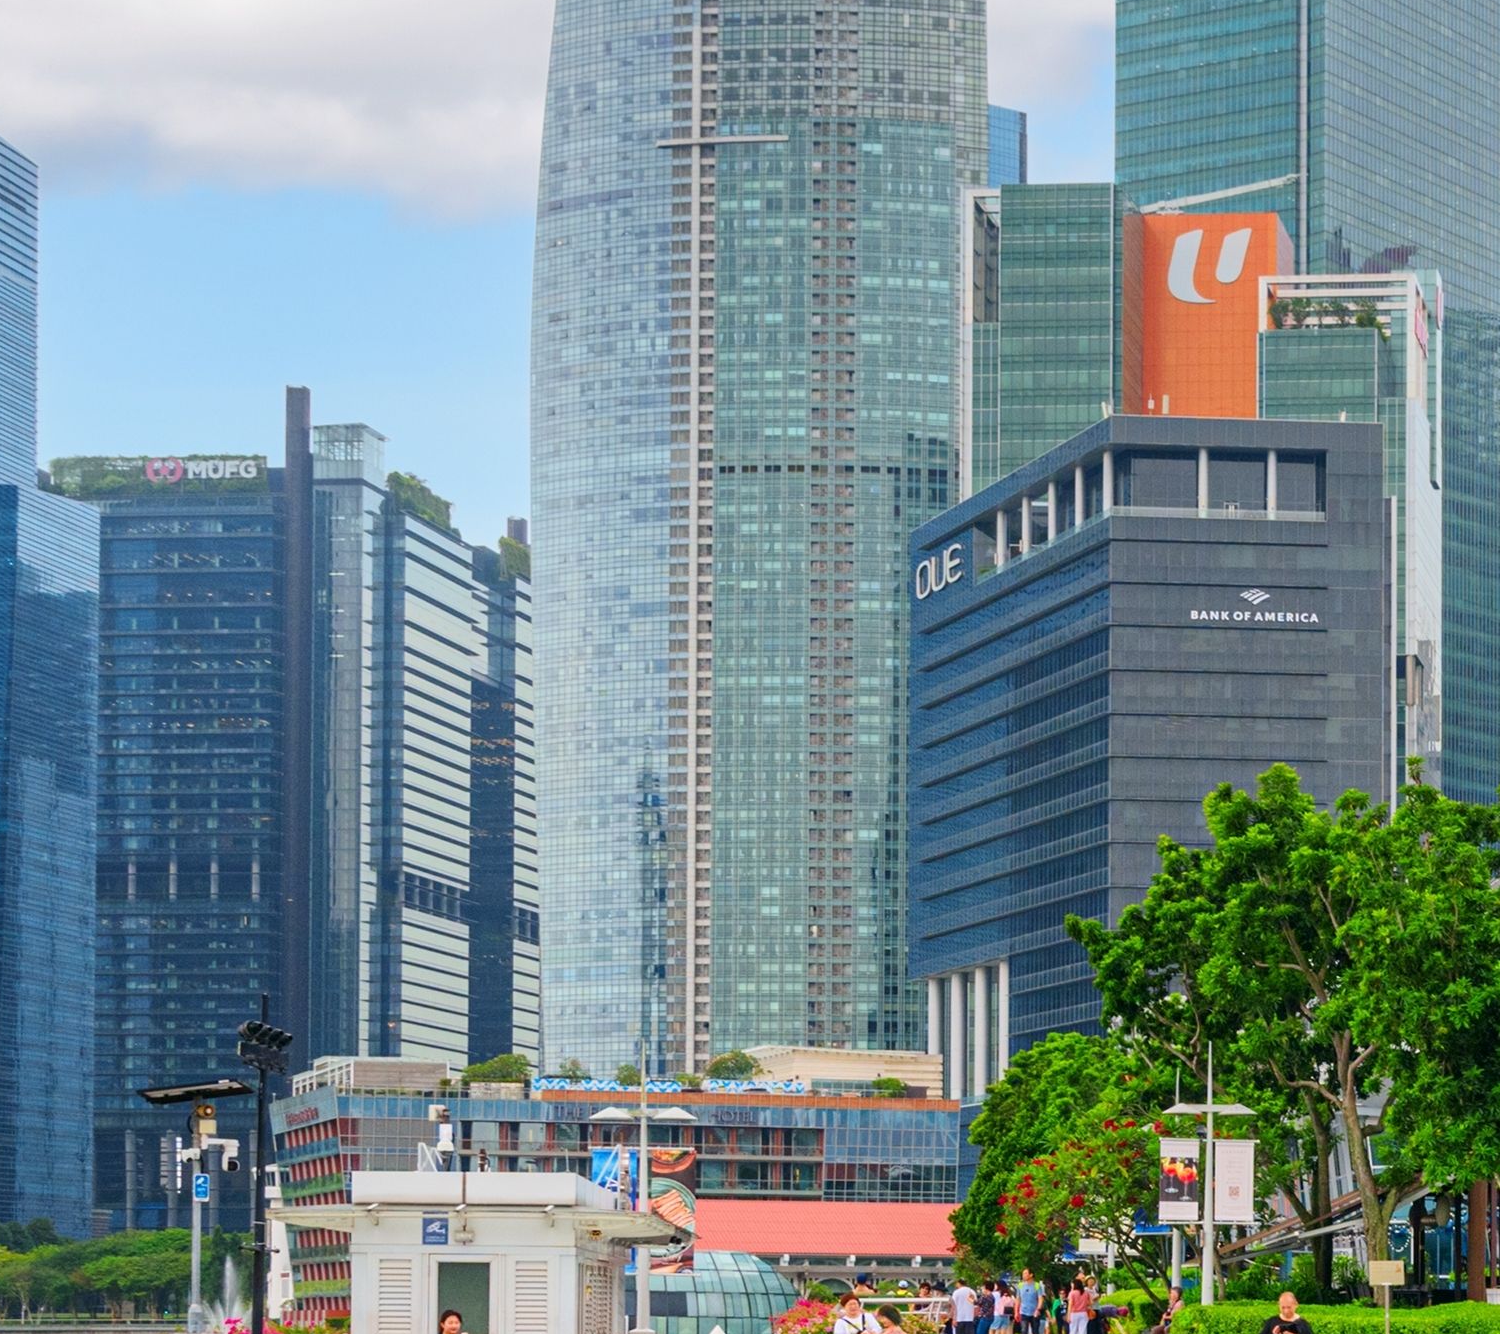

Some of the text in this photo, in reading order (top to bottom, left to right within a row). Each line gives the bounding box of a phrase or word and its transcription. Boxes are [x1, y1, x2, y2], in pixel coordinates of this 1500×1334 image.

[186, 459, 258, 479] MUFG
[916, 543, 963, 600] OUE
[1190, 610, 1319, 623] BANK OF AMERICA
